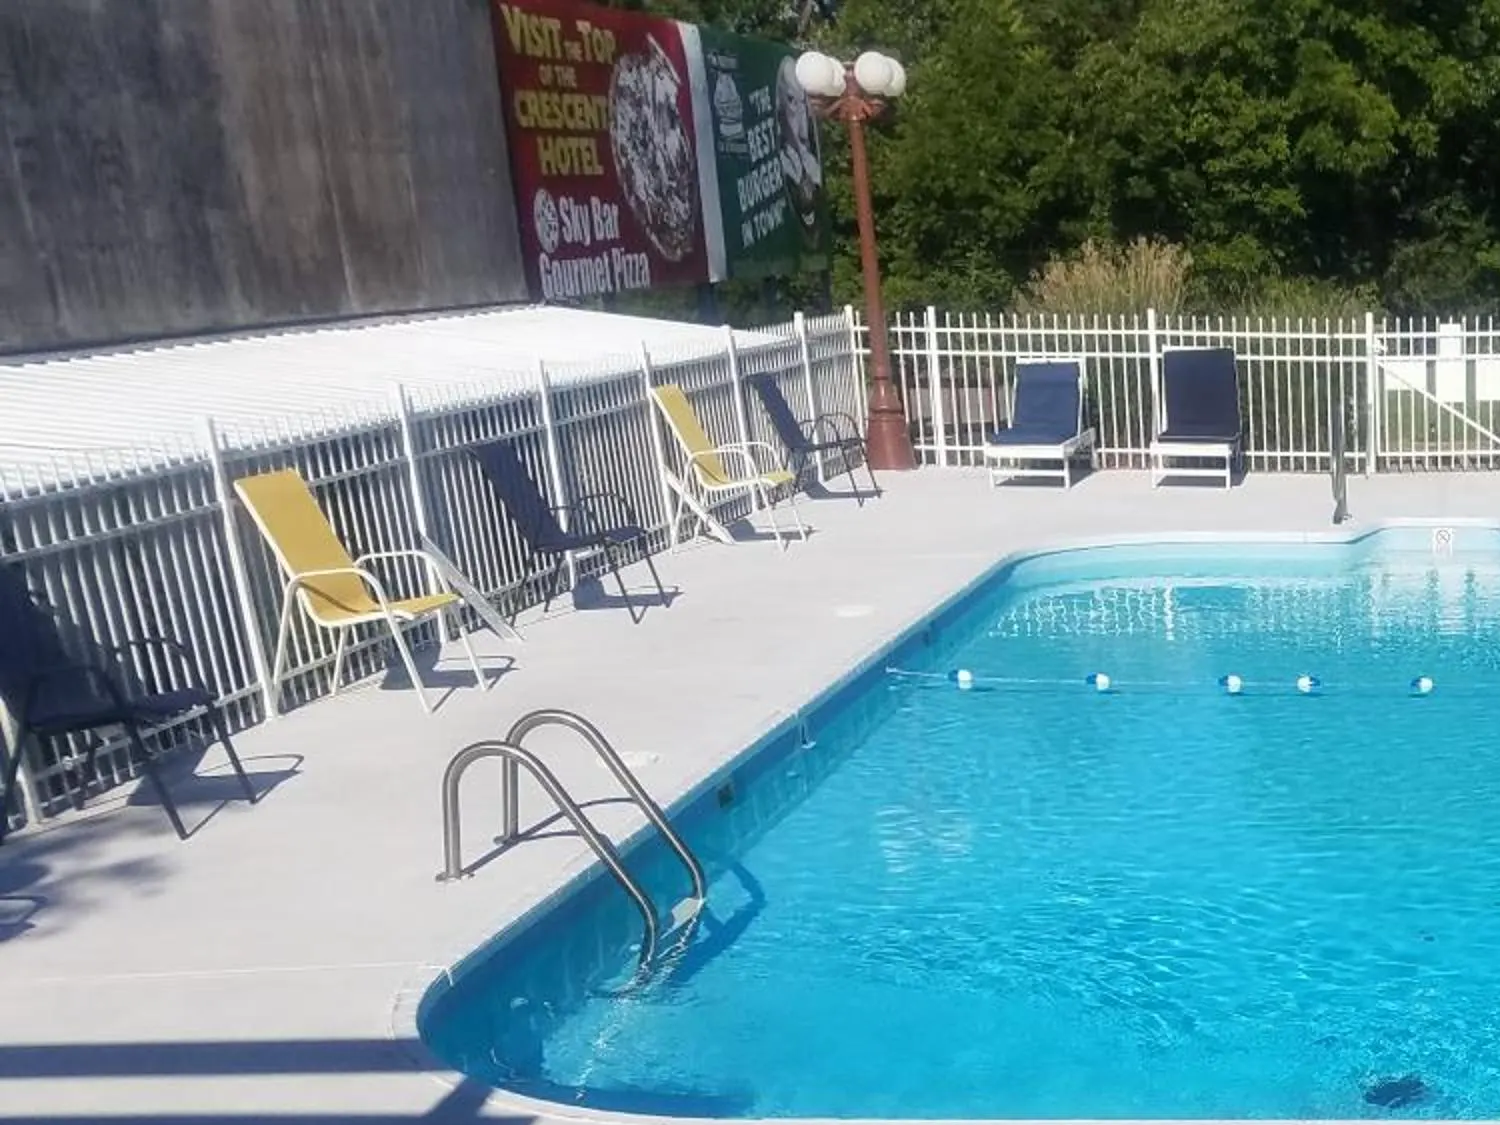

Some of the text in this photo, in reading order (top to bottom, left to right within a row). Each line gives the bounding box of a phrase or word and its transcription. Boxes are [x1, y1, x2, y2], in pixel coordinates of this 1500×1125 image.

[500, 3, 562, 59] VISIT
[576, 20, 617, 65] TOP
[554, 65, 577, 89] THE
[514, 89, 609, 131] CRESCENT
[537, 136, 604, 177] HOTEL
[747, 117, 776, 162] BEST
[737, 158, 784, 213] BURGER
[559, 196, 620, 247] Sky Bar
[540, 247, 651, 299] Gourmet Pizza
